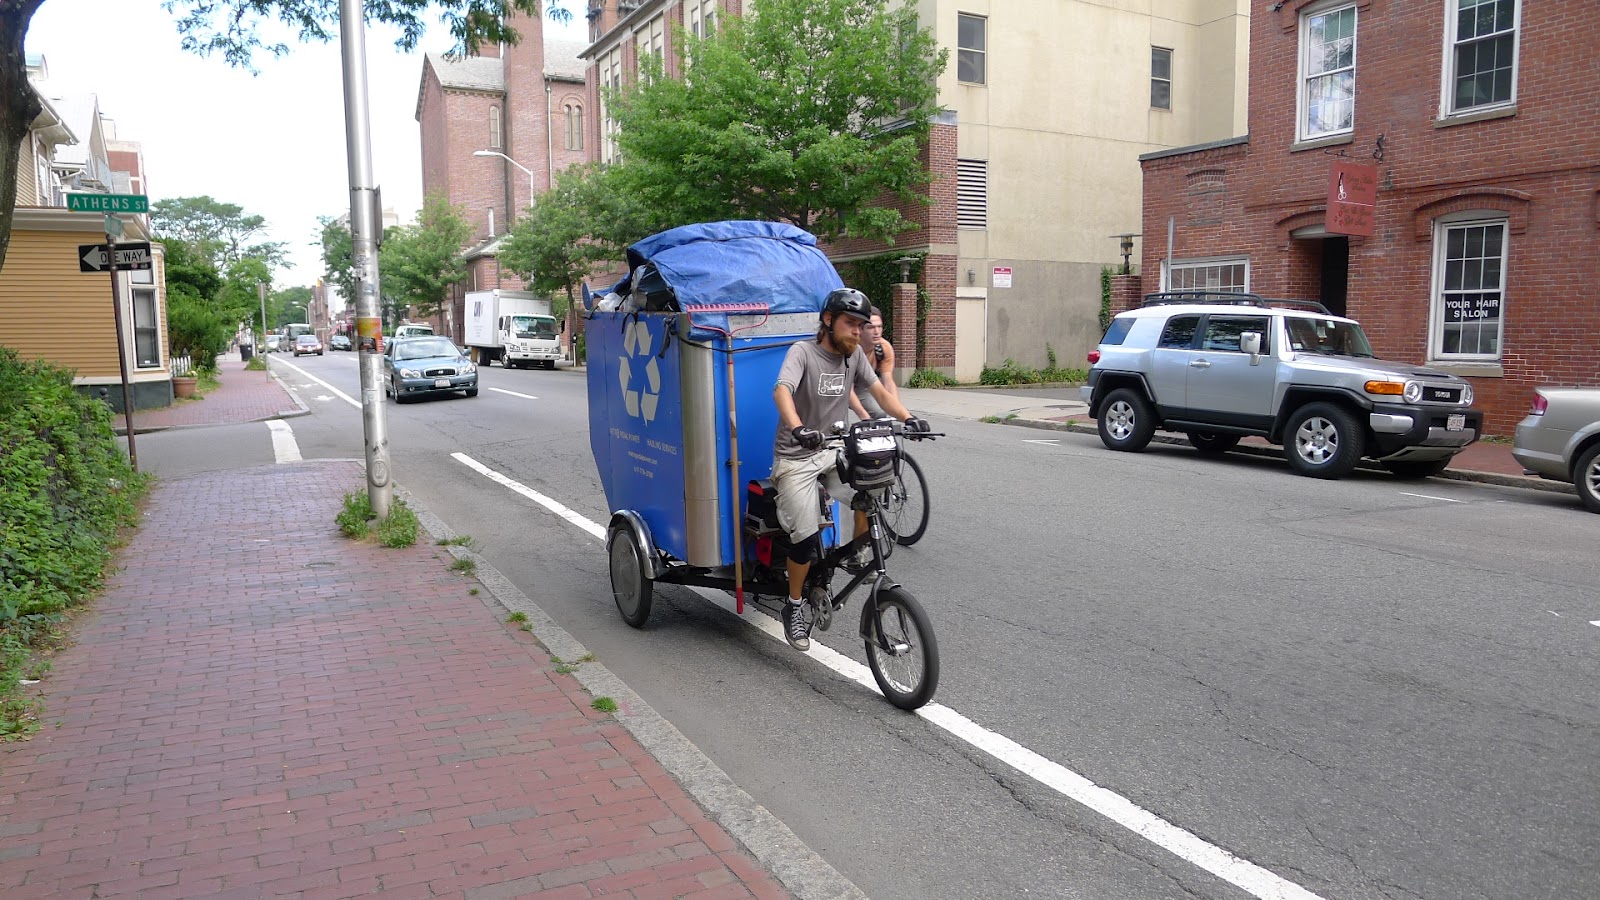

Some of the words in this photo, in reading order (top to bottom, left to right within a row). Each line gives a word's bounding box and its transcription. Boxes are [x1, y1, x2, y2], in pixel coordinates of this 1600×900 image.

[72, 197, 130, 209] ATHENS
[135, 201, 146, 209] ST
[101, 252, 120, 263] OE
[123, 251, 143, 262] WAY
[1446, 301, 1470, 309] YOUR
[1476, 300, 1499, 308] HAIR
[1453, 310, 1489, 318] SALON
